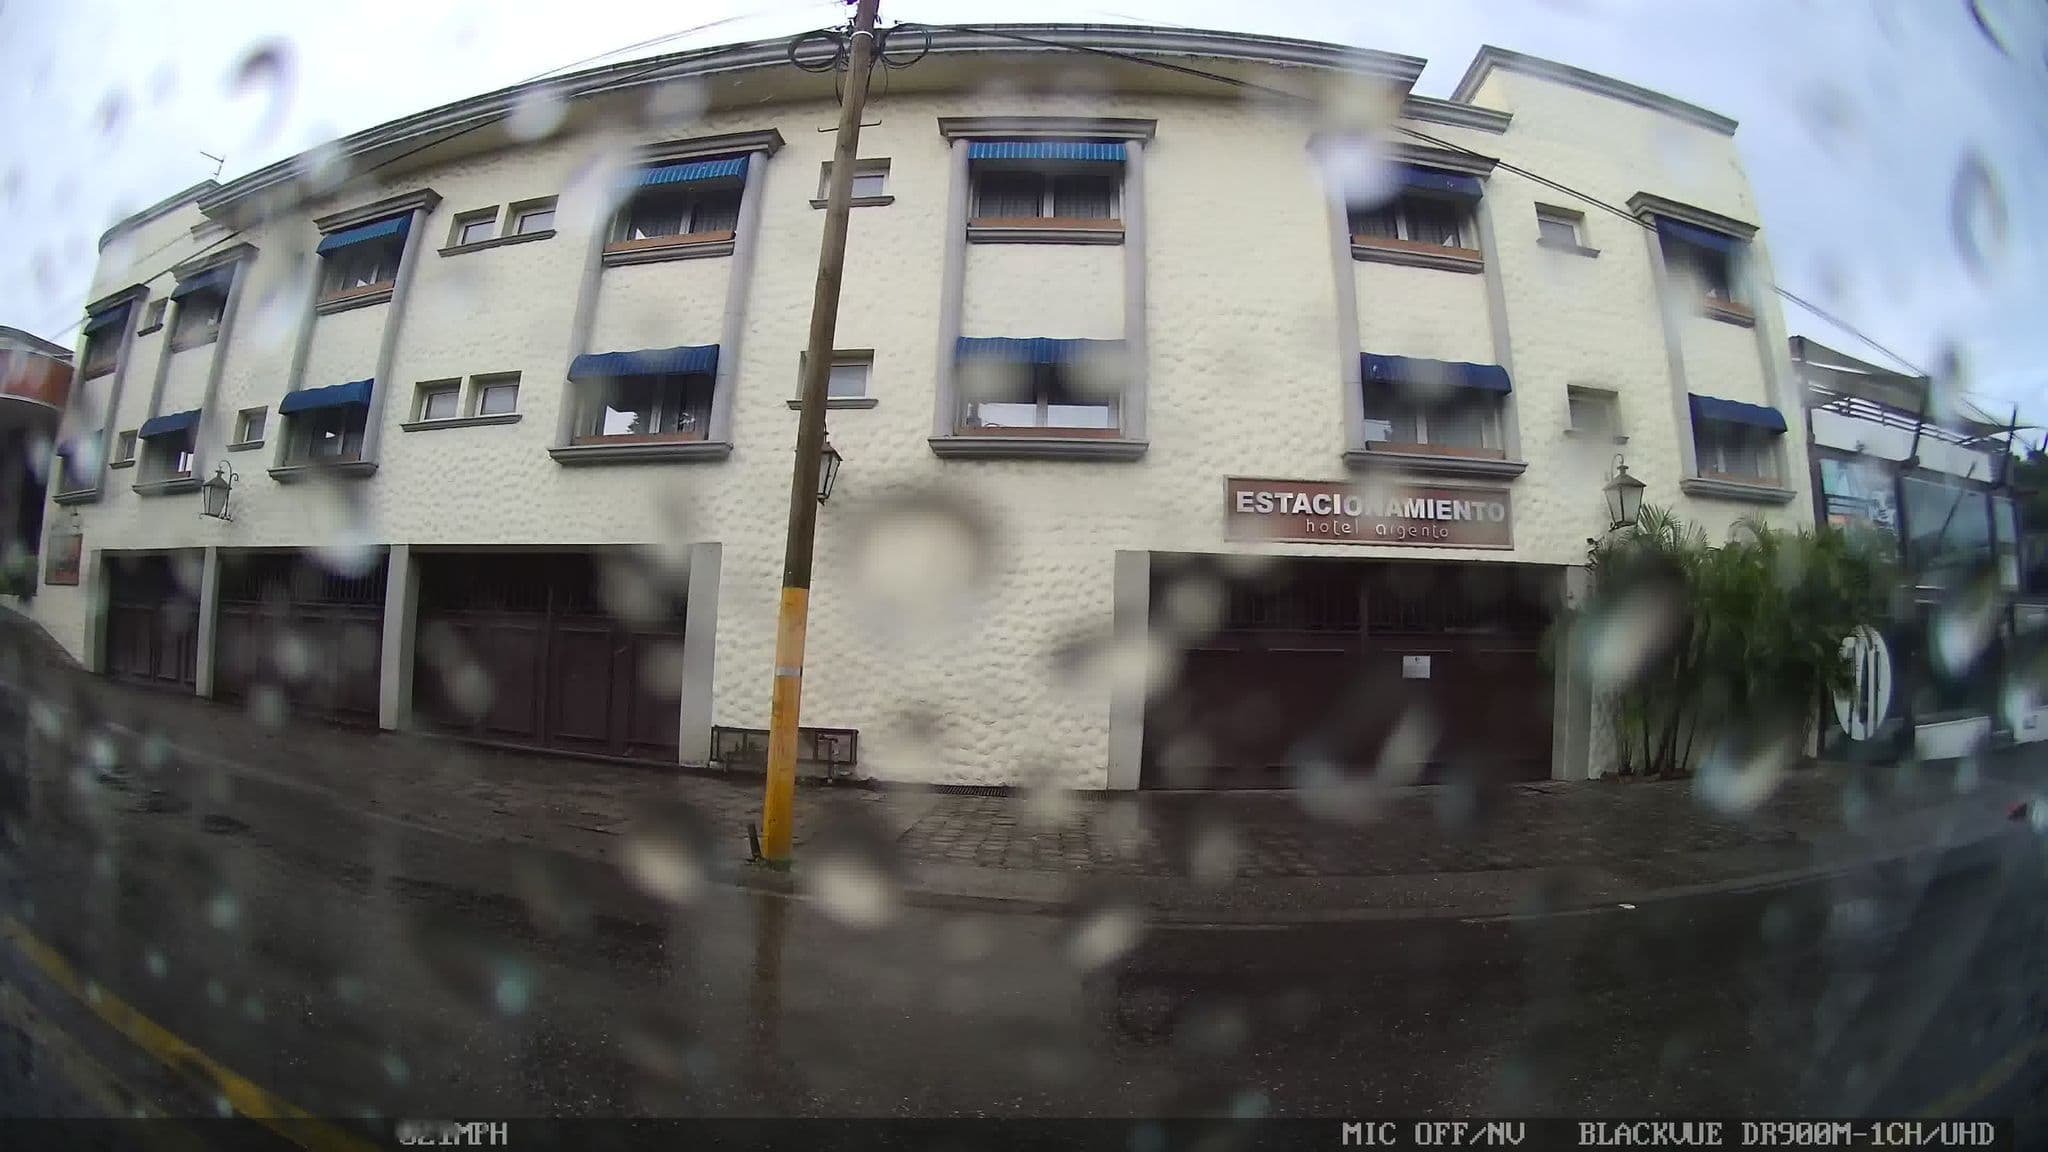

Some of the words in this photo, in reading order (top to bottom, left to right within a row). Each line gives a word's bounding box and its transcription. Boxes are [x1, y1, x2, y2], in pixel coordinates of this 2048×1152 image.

[1235, 491, 1505, 522] ESTACIOAMIENTO
[1305, 518, 1360, 537] hotel
[1375, 522, 1450, 540] argento
